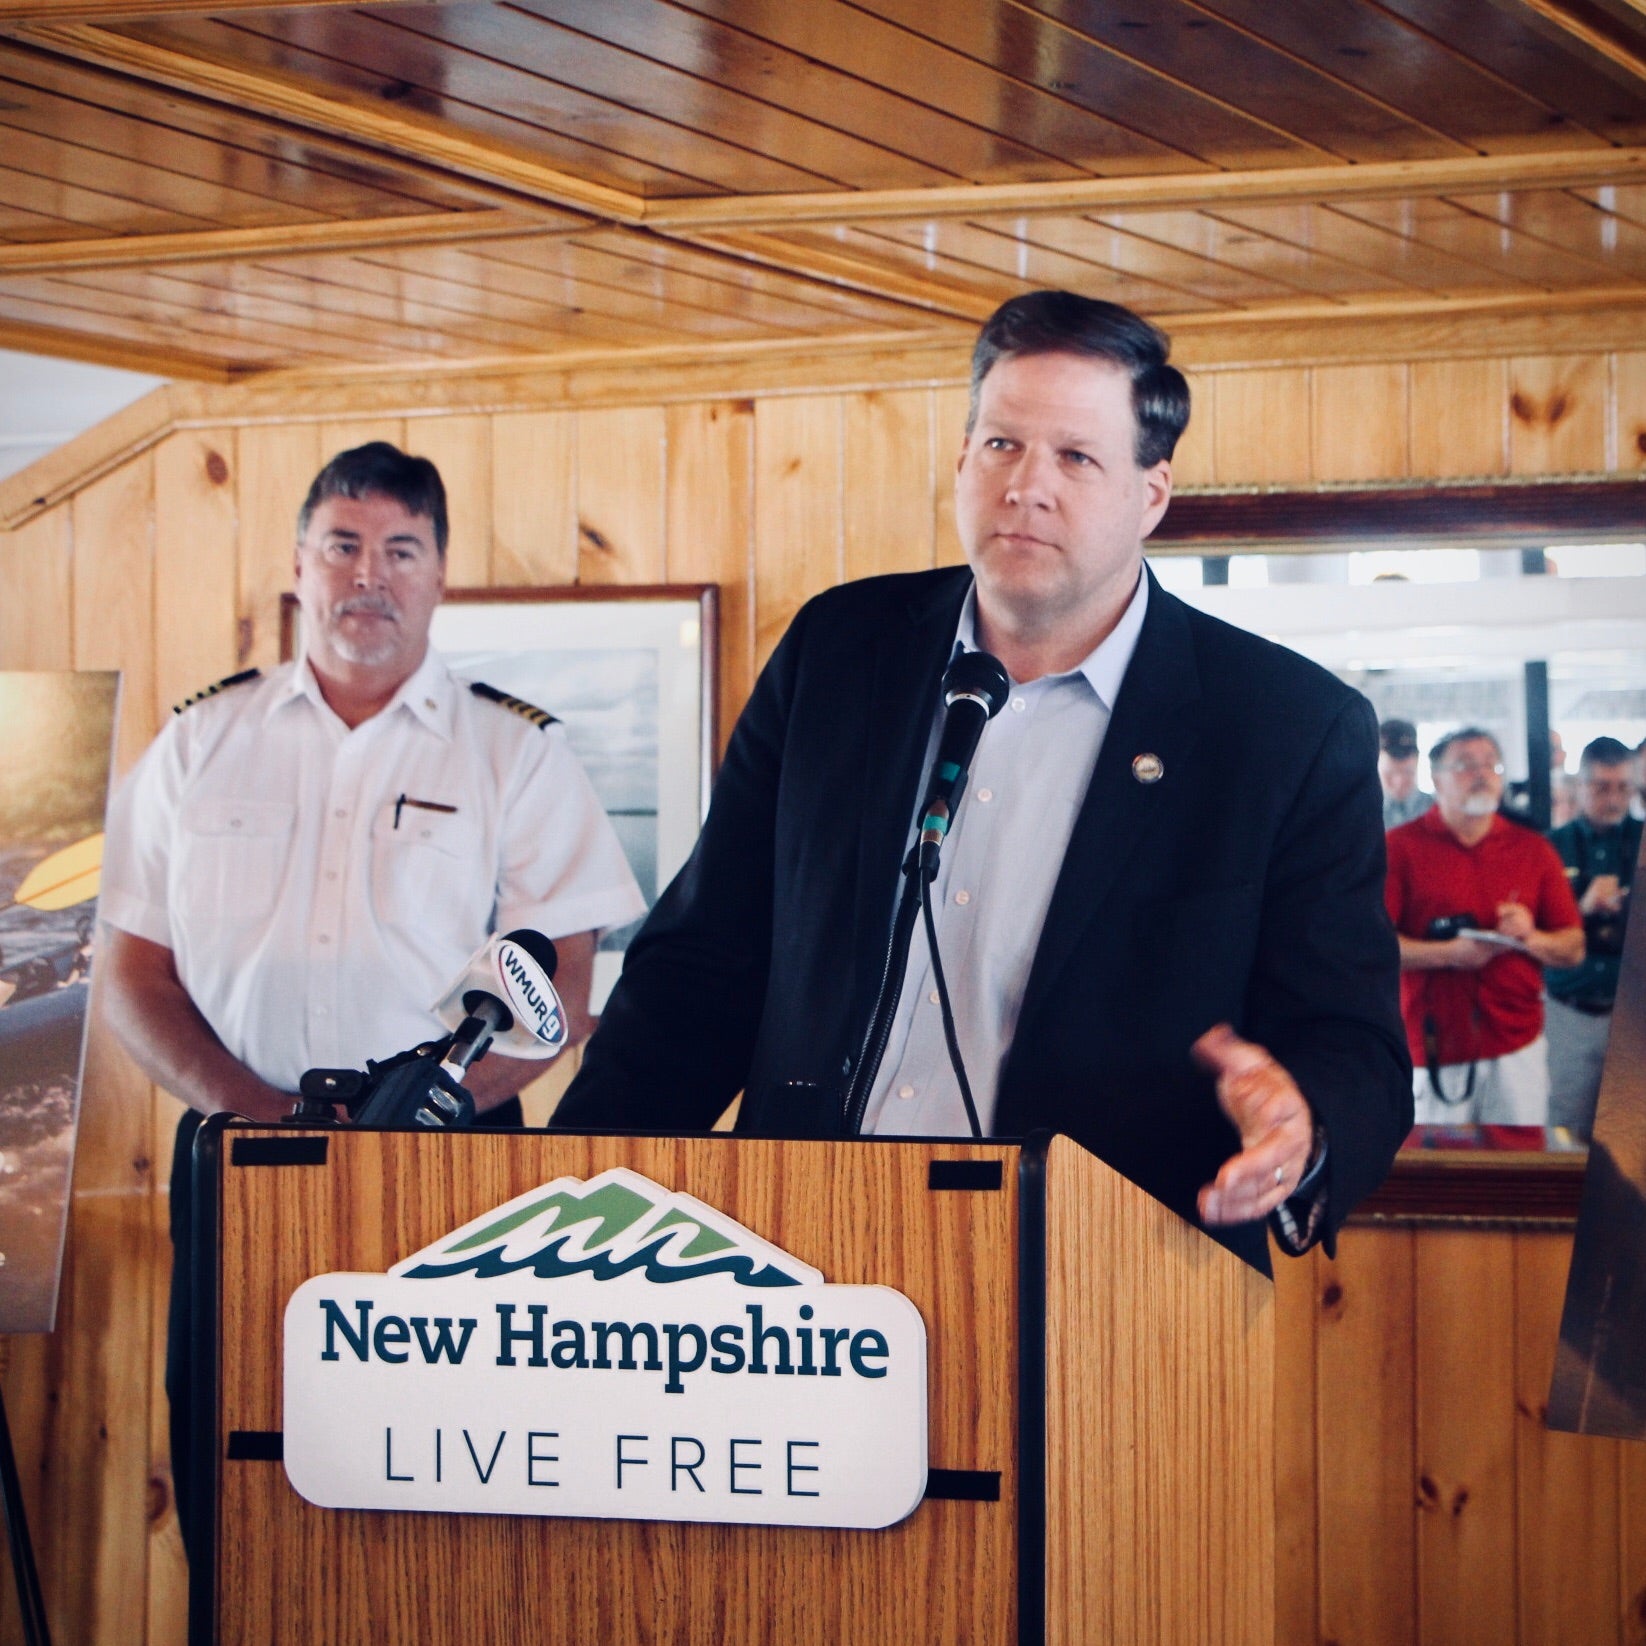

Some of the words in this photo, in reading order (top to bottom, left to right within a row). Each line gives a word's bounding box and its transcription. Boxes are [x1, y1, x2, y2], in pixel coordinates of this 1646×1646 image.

[505, 950, 548, 1021] WMUR
[319, 1299, 478, 1365] New
[495, 1303, 890, 1394] Hampshire
[386, 1427, 560, 1487] LIVE
[616, 1434, 820, 1497] FREE
